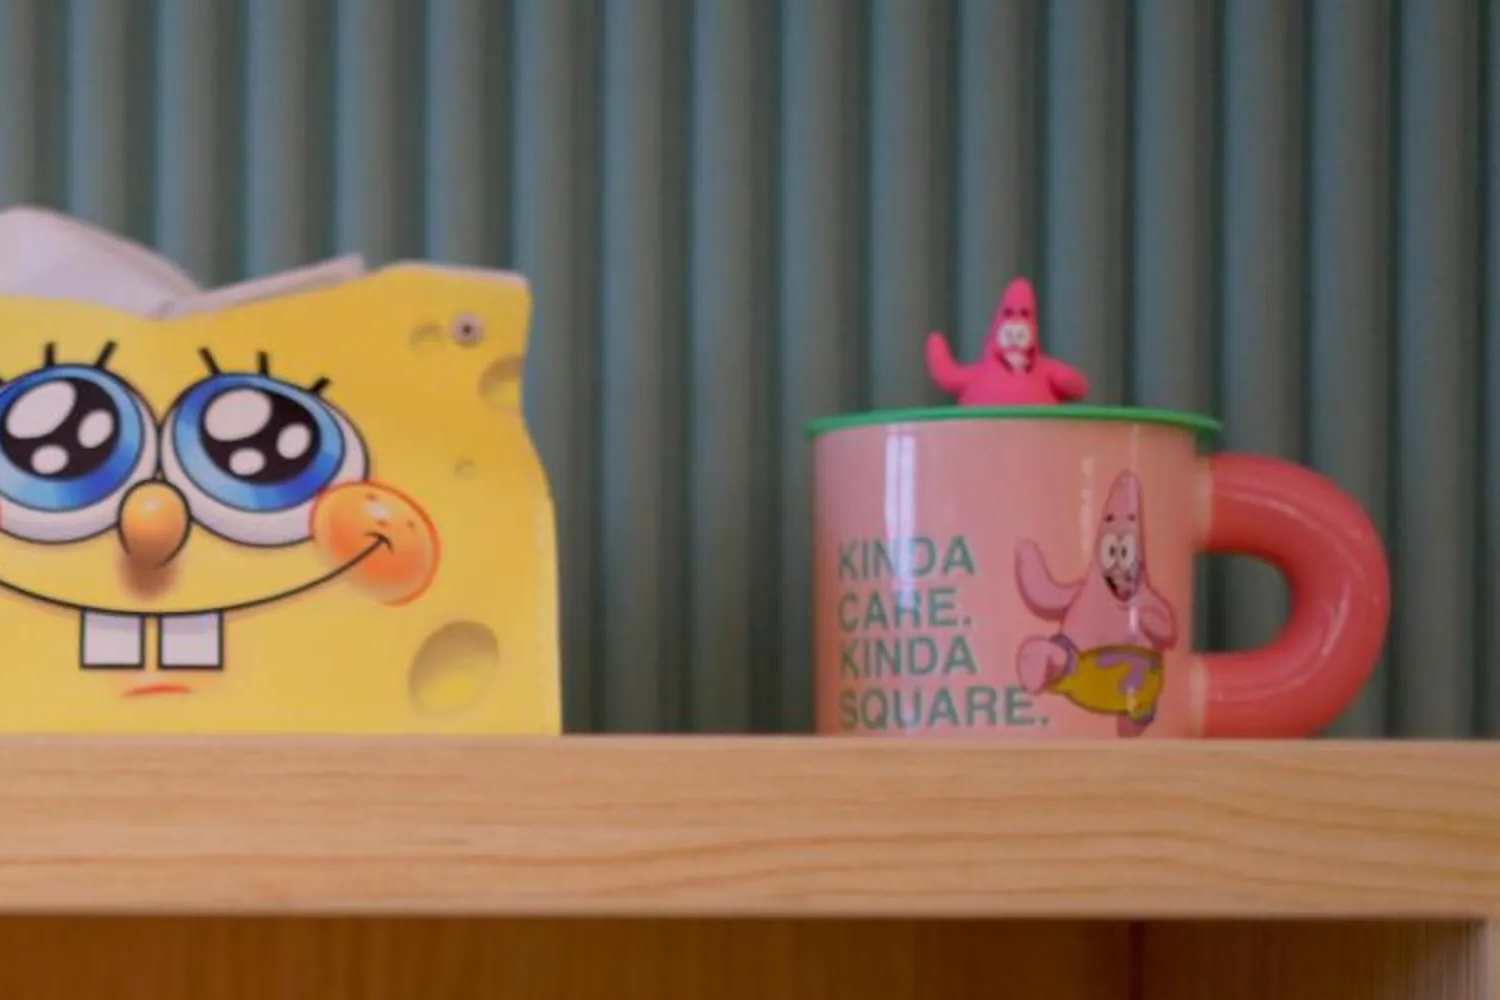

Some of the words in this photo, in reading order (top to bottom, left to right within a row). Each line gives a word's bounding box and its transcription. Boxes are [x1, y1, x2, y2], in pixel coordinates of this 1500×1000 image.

[838, 535, 976, 580] KINDA
[837, 586, 972, 631] CARE.
[838, 635, 977, 679] KINDA
[839, 685, 1051, 731] SQUARE.
